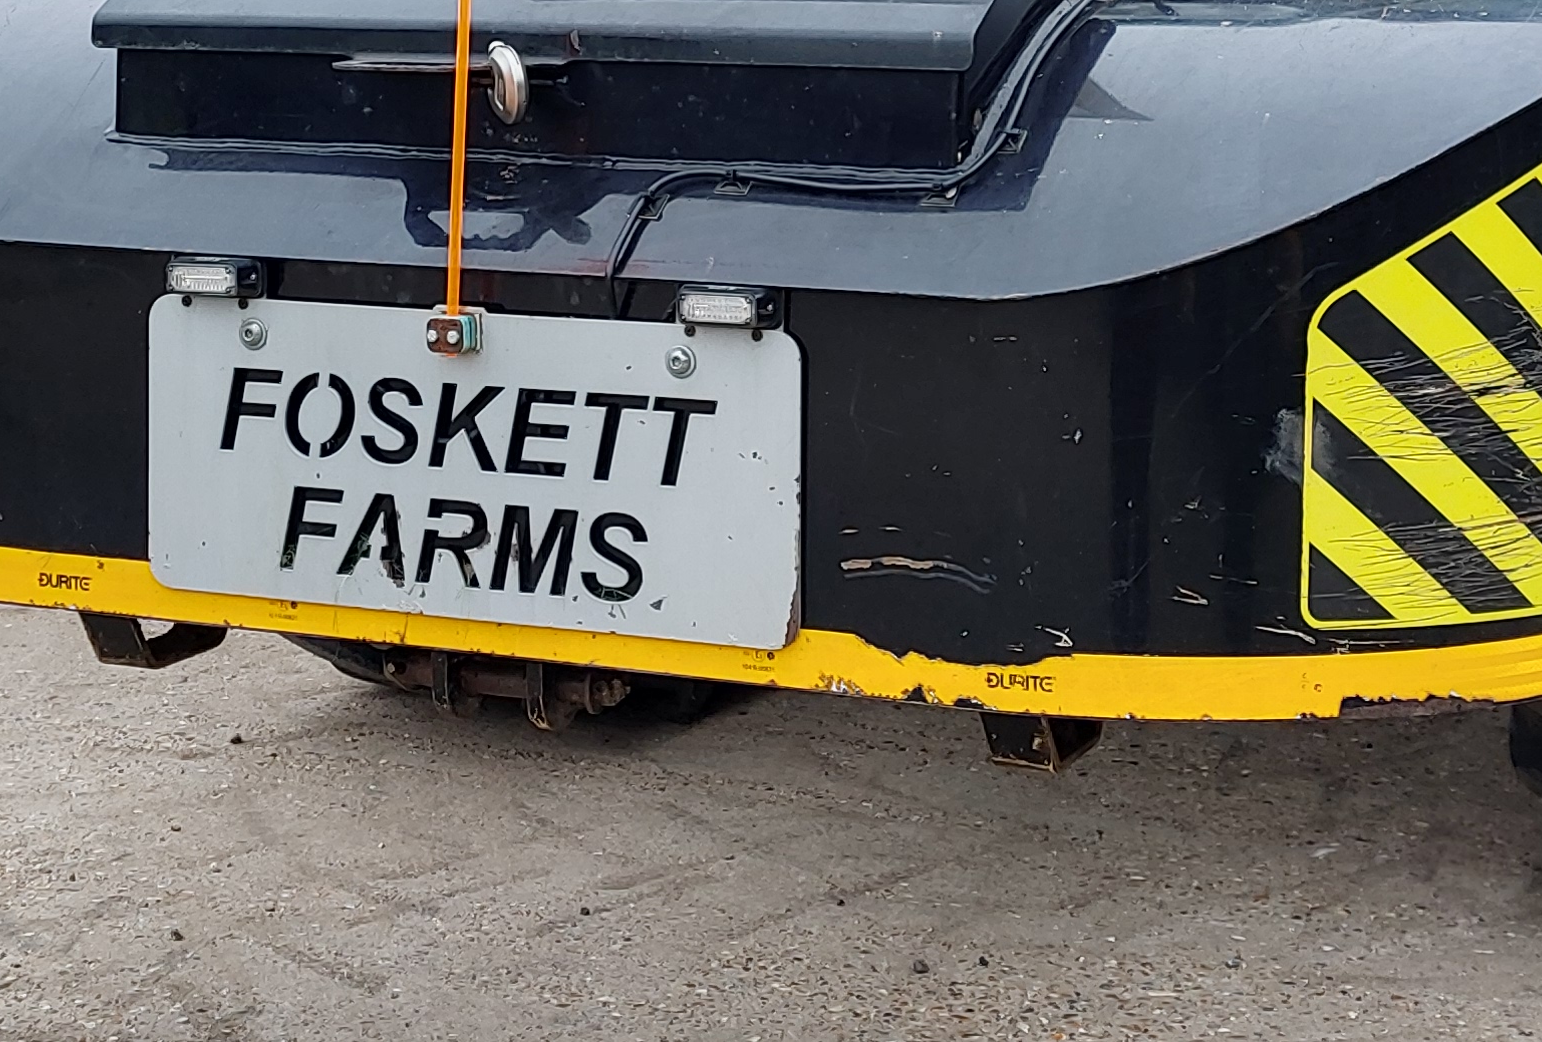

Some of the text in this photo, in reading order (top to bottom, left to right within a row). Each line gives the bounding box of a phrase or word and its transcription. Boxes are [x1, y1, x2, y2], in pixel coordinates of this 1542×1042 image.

[219, 367, 719, 487] FOSKETT
[37, 572, 93, 592] DURITE
[279, 485, 649, 603] FARMS
